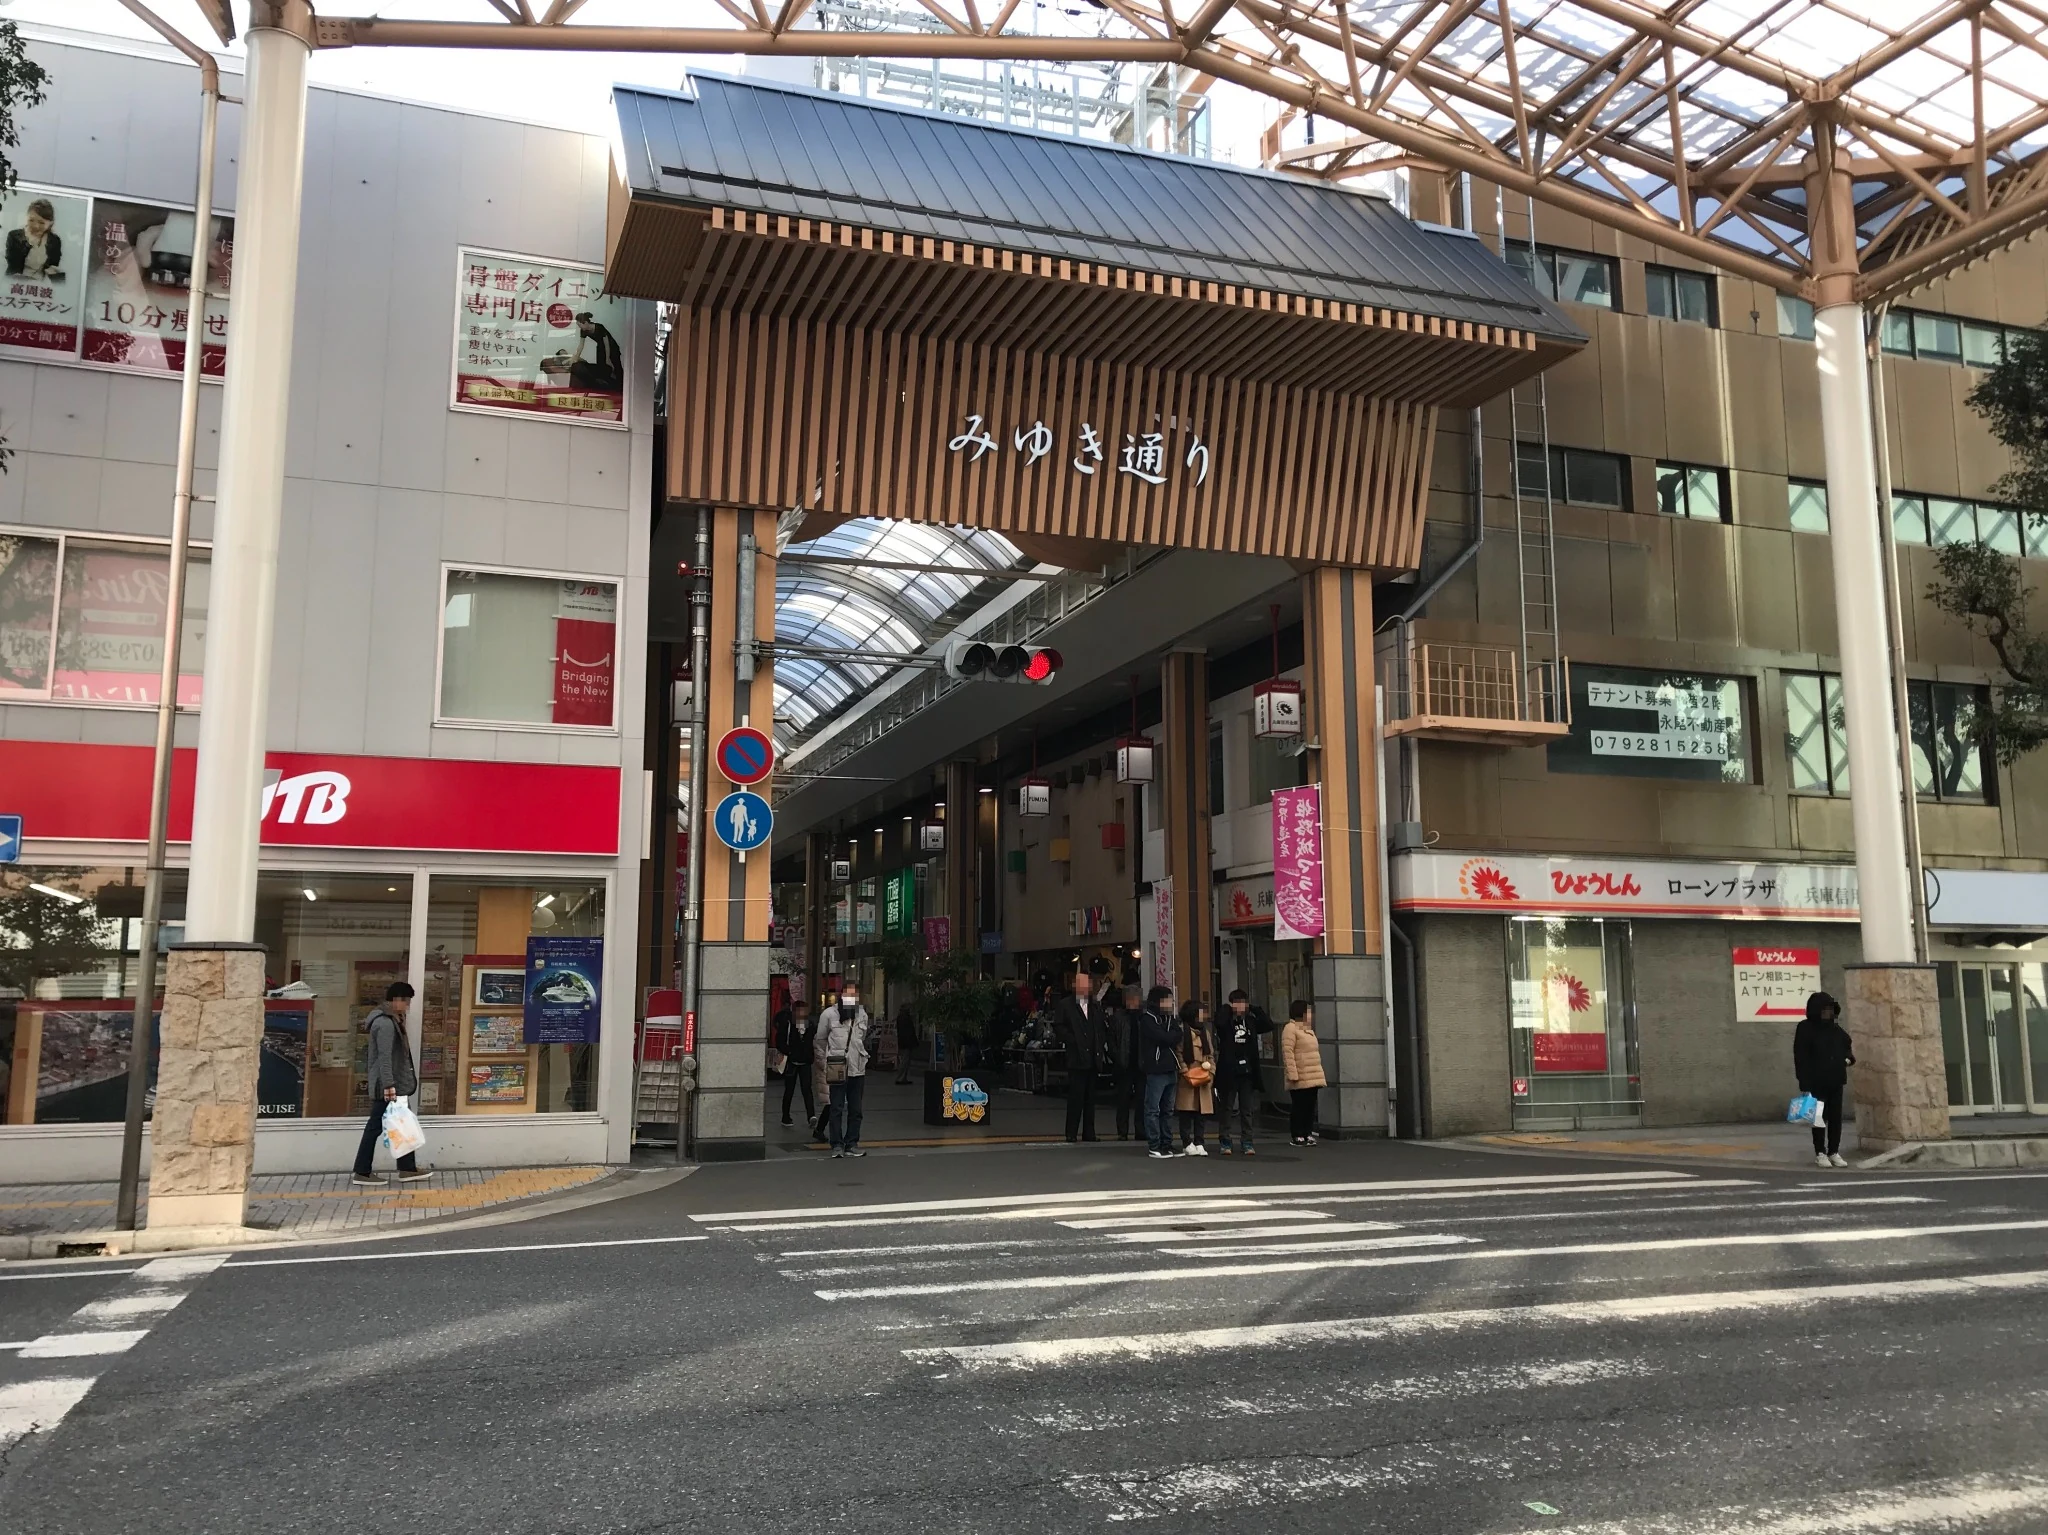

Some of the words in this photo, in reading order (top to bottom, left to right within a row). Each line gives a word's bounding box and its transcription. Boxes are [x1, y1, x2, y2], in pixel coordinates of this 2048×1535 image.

[104, 221, 127, 275] 温めて
[10, 283, 54, 299] 高周波
[0, 296, 73, 314] ステマシン
[465, 293, 543, 323] 専門店
[468, 340, 527, 354] 痩せやすい
[949, 414, 1209, 487] みゆき通り
[562, 670, 610, 686] Bridging
[562, 684, 580, 694] the
[583, 685, 609, 697] New
[1594, 736, 1727, 755] 0792815258
[1551, 871, 1642, 896] ひょうしん
[1668, 878, 1777, 900] ローンプラザ
[1757, 950, 1797, 963] ひょうしん
[1739, 971, 1815, 982] ローン相談コーナー
[1741, 986, 1817, 997] ATMコーナー
[257, 1103, 297, 1115] RUISE
